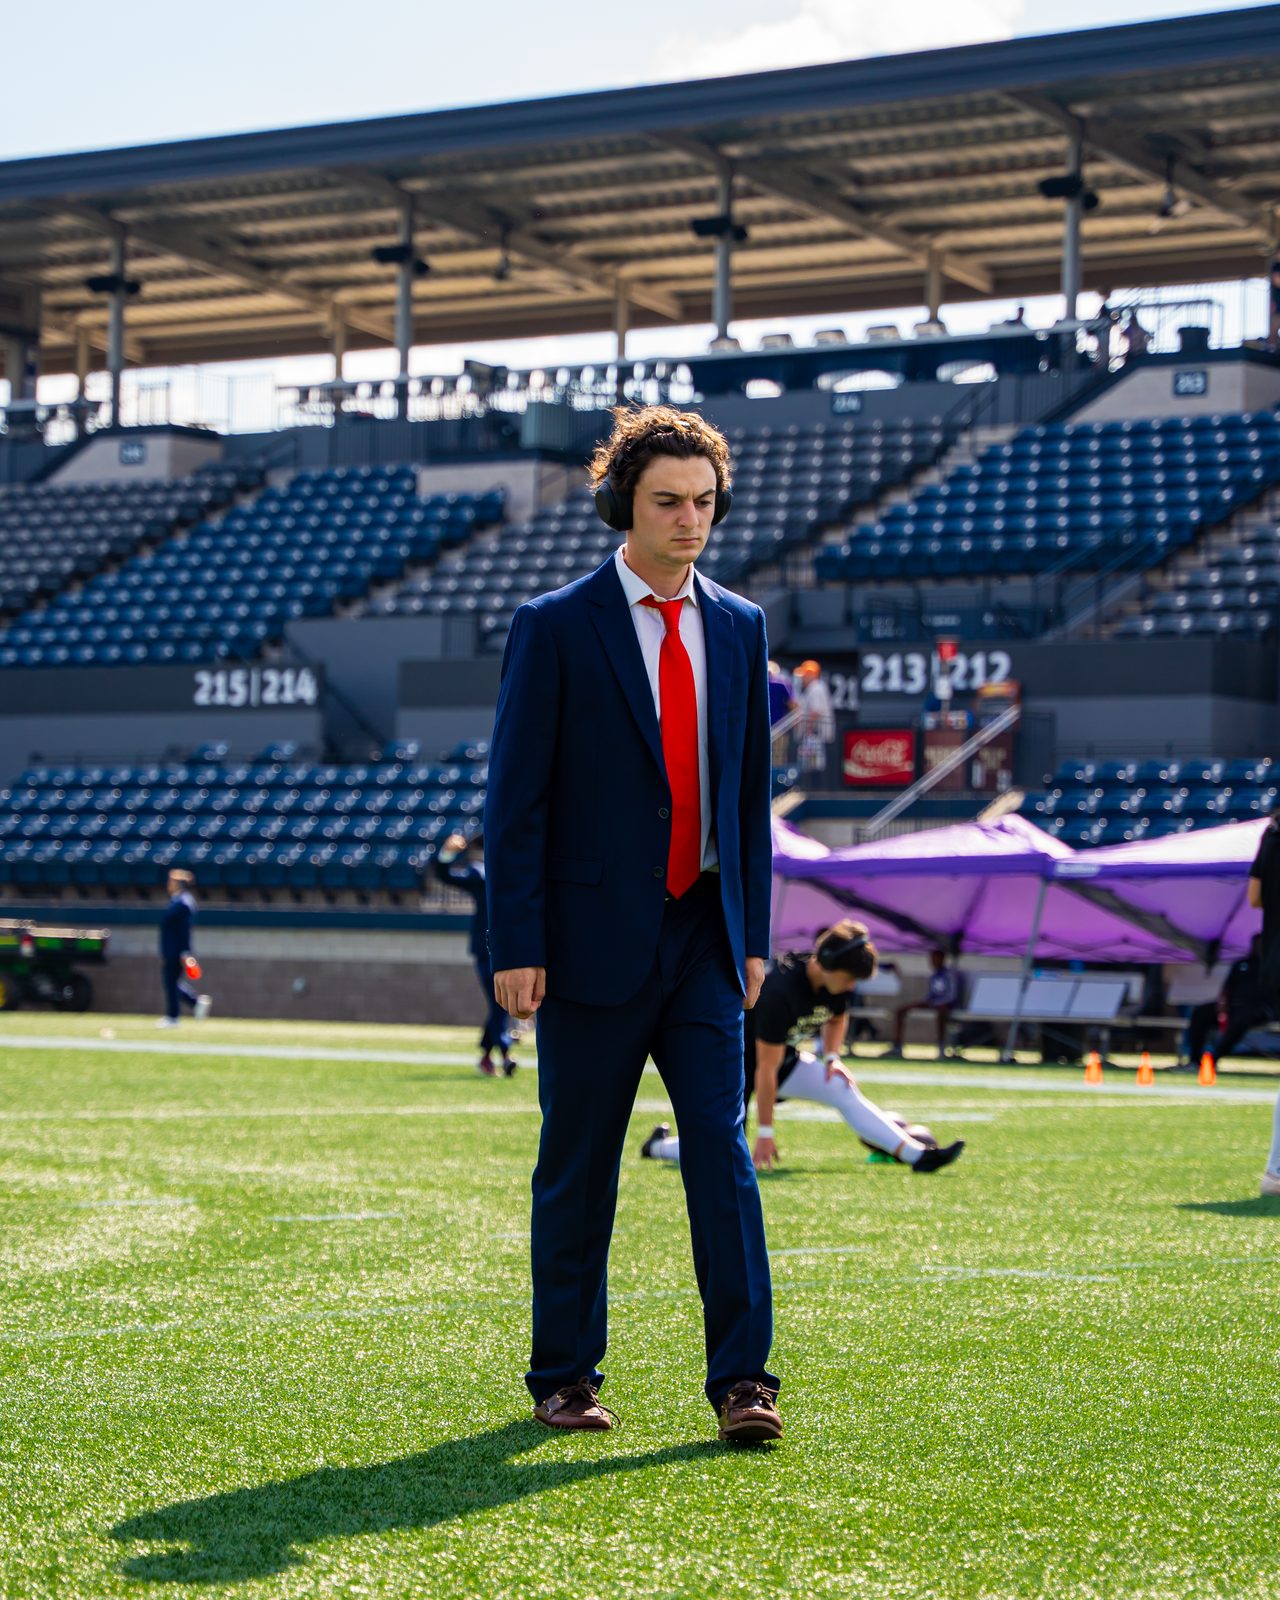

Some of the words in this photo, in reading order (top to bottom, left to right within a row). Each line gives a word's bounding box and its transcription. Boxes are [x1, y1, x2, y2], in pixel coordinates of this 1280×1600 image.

[193, 669, 248, 706] 215
[261, 667, 318, 705] 214
[861, 653, 926, 694] 213
[948, 650, 1011, 690] 212
